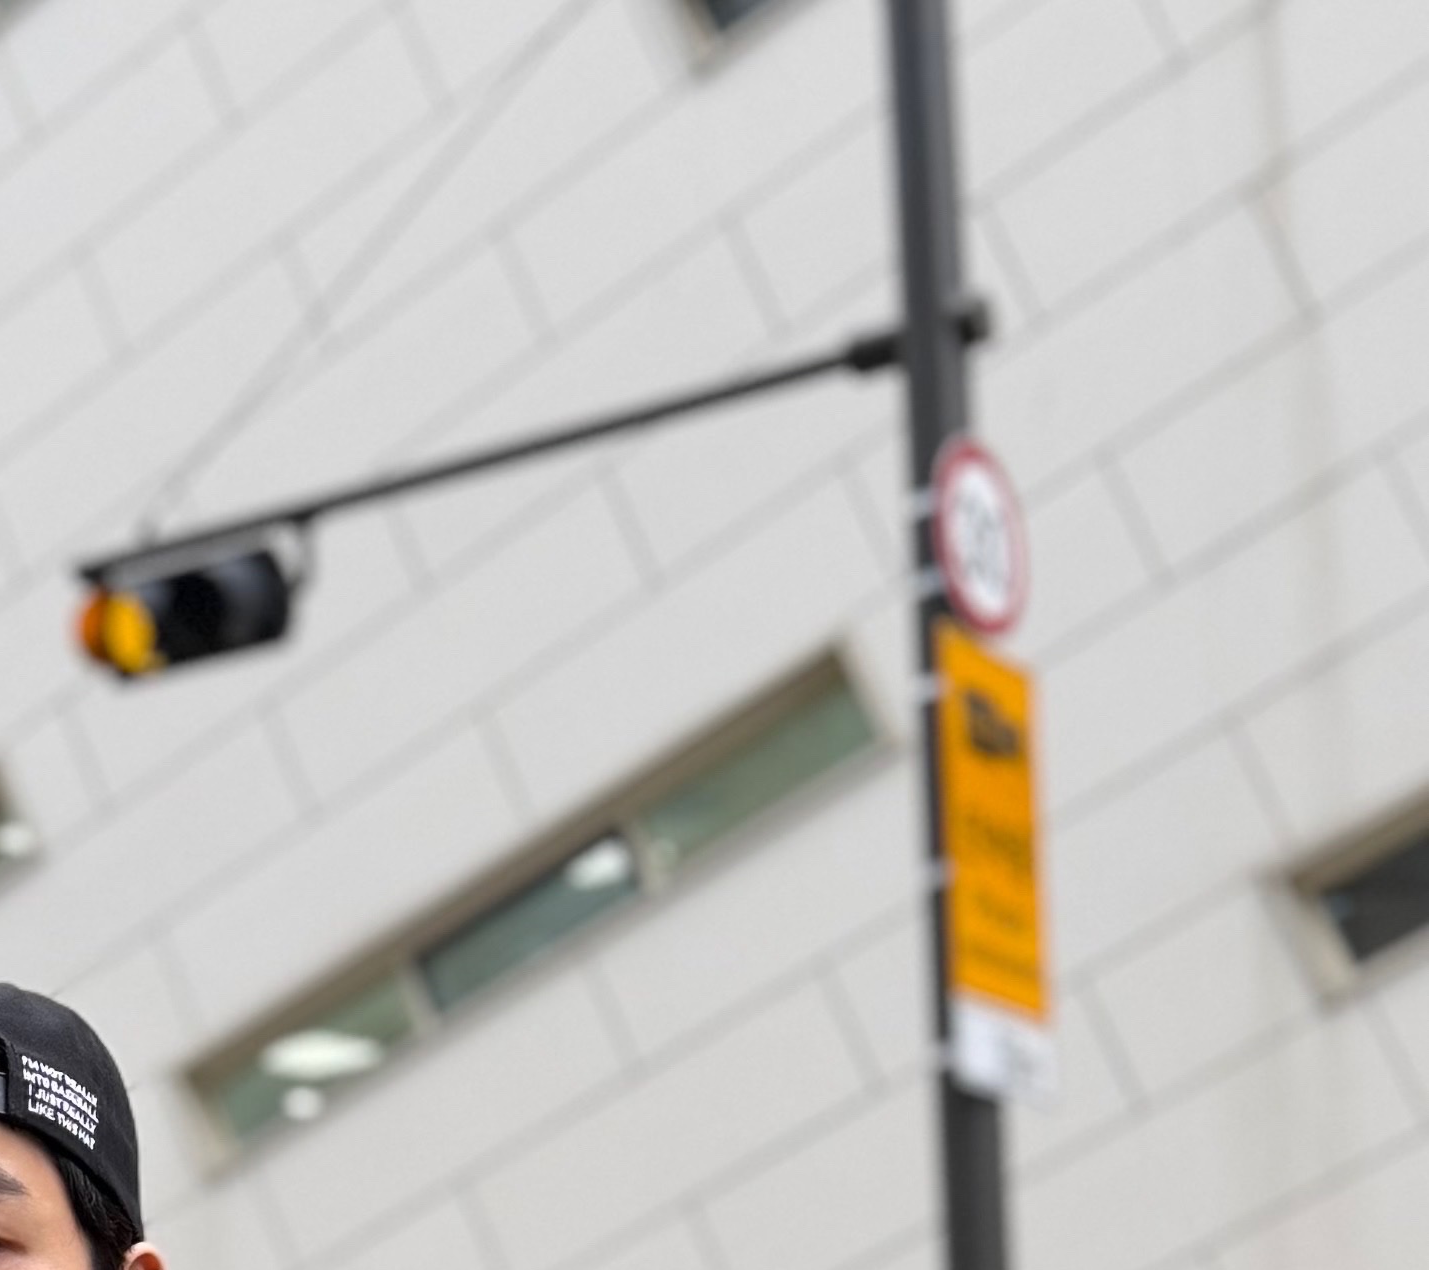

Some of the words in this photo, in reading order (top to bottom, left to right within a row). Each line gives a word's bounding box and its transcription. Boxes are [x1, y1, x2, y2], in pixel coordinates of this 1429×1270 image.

[23, 1068, 50, 1088] INTO
[51, 1080, 99, 1123] BASEBALL
[28, 1083, 32, 1096] I
[35, 1089, 63, 1108] JUST
[62, 1099, 96, 1134] REALLY
[40, 1063, 63, 1081] NOT
[65, 1074, 97, 1107] REALLY
[28, 1098, 55, 1120] LIKE
[57, 1112, 78, 1136] THIS
[78, 1129, 96, 1150] HAT
